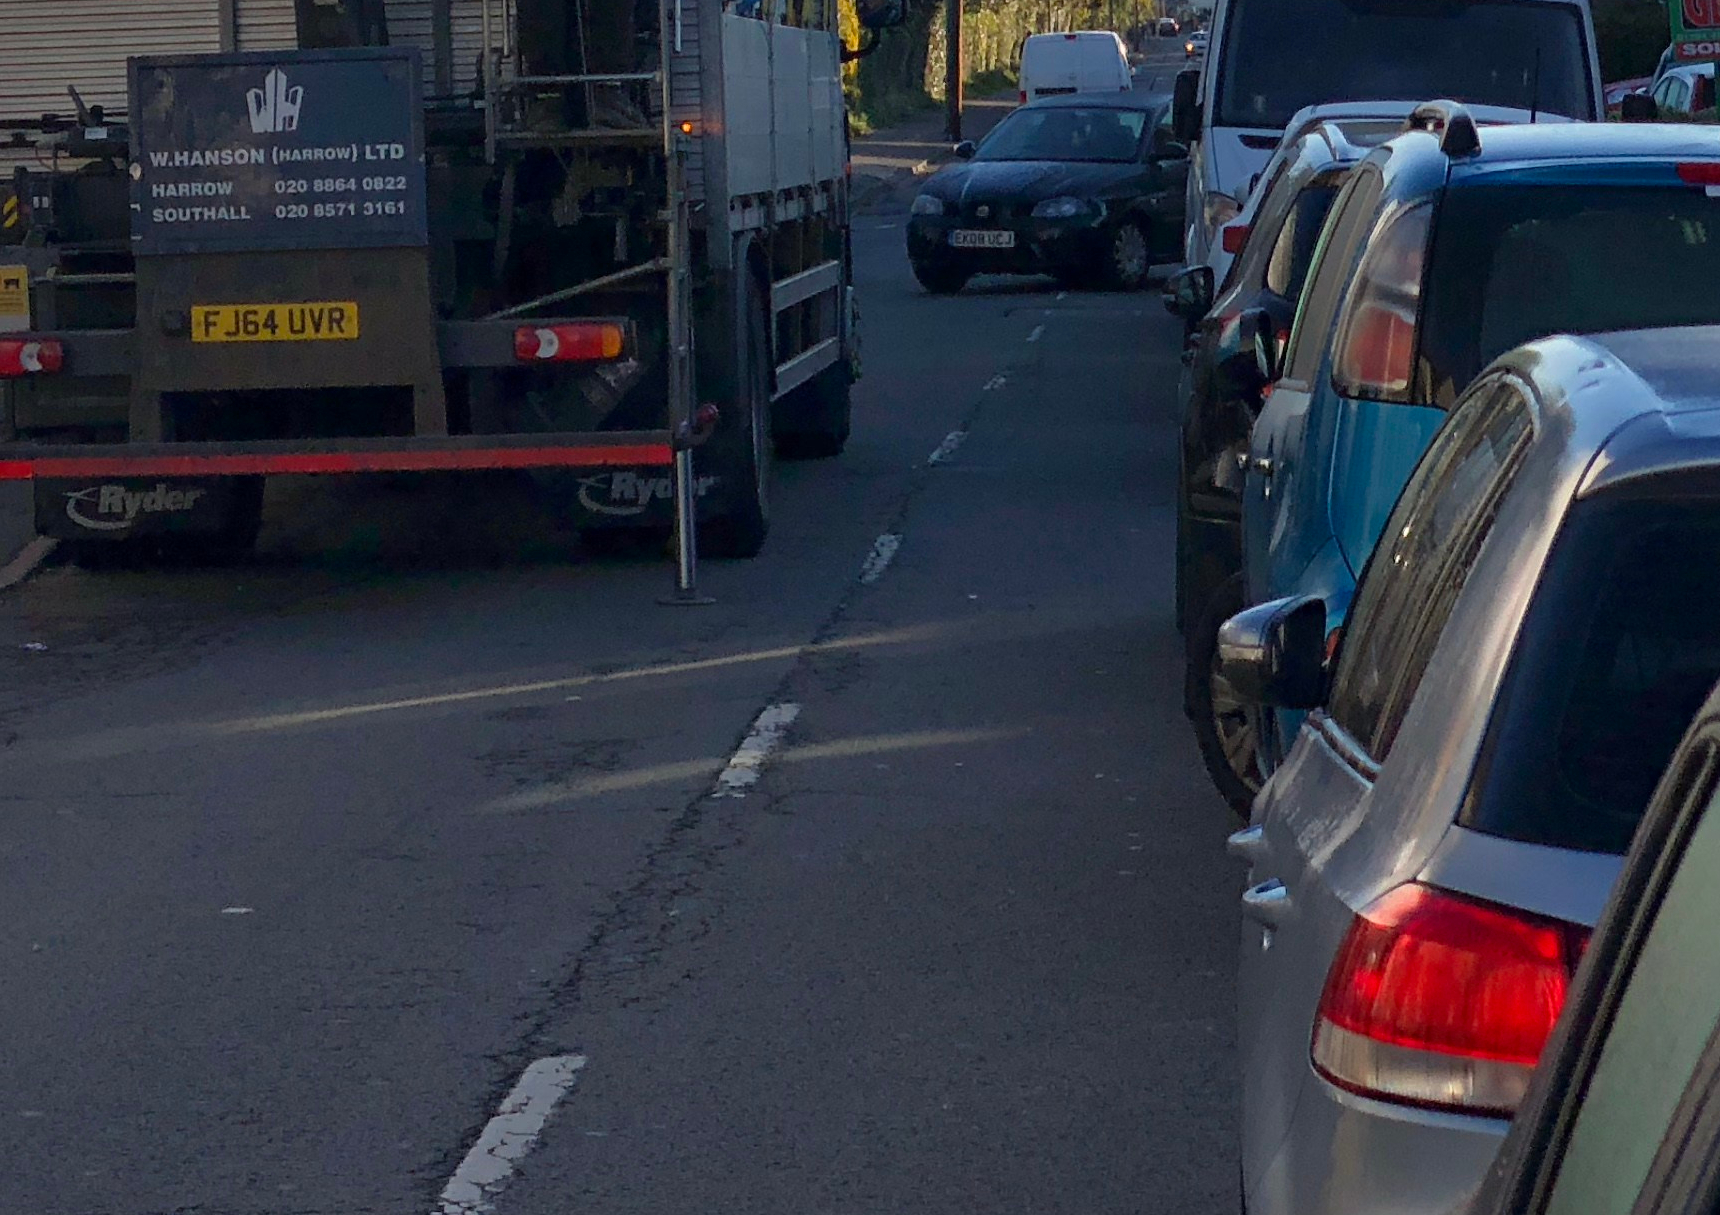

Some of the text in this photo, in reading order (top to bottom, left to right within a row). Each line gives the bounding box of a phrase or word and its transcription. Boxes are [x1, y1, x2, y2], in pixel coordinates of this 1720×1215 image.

[272, 145, 358, 165] (HARROW)
[364, 143, 405, 160] LTD
[152, 176, 407, 198] HARROW 020 8864 0822
[152, 201, 405, 222] SOUTHALL 020 8571 3161
[203, 307, 345, 337] FJ64 UVR
[610, 471, 719, 505] Rydr
[97, 484, 207, 520] Ryder
